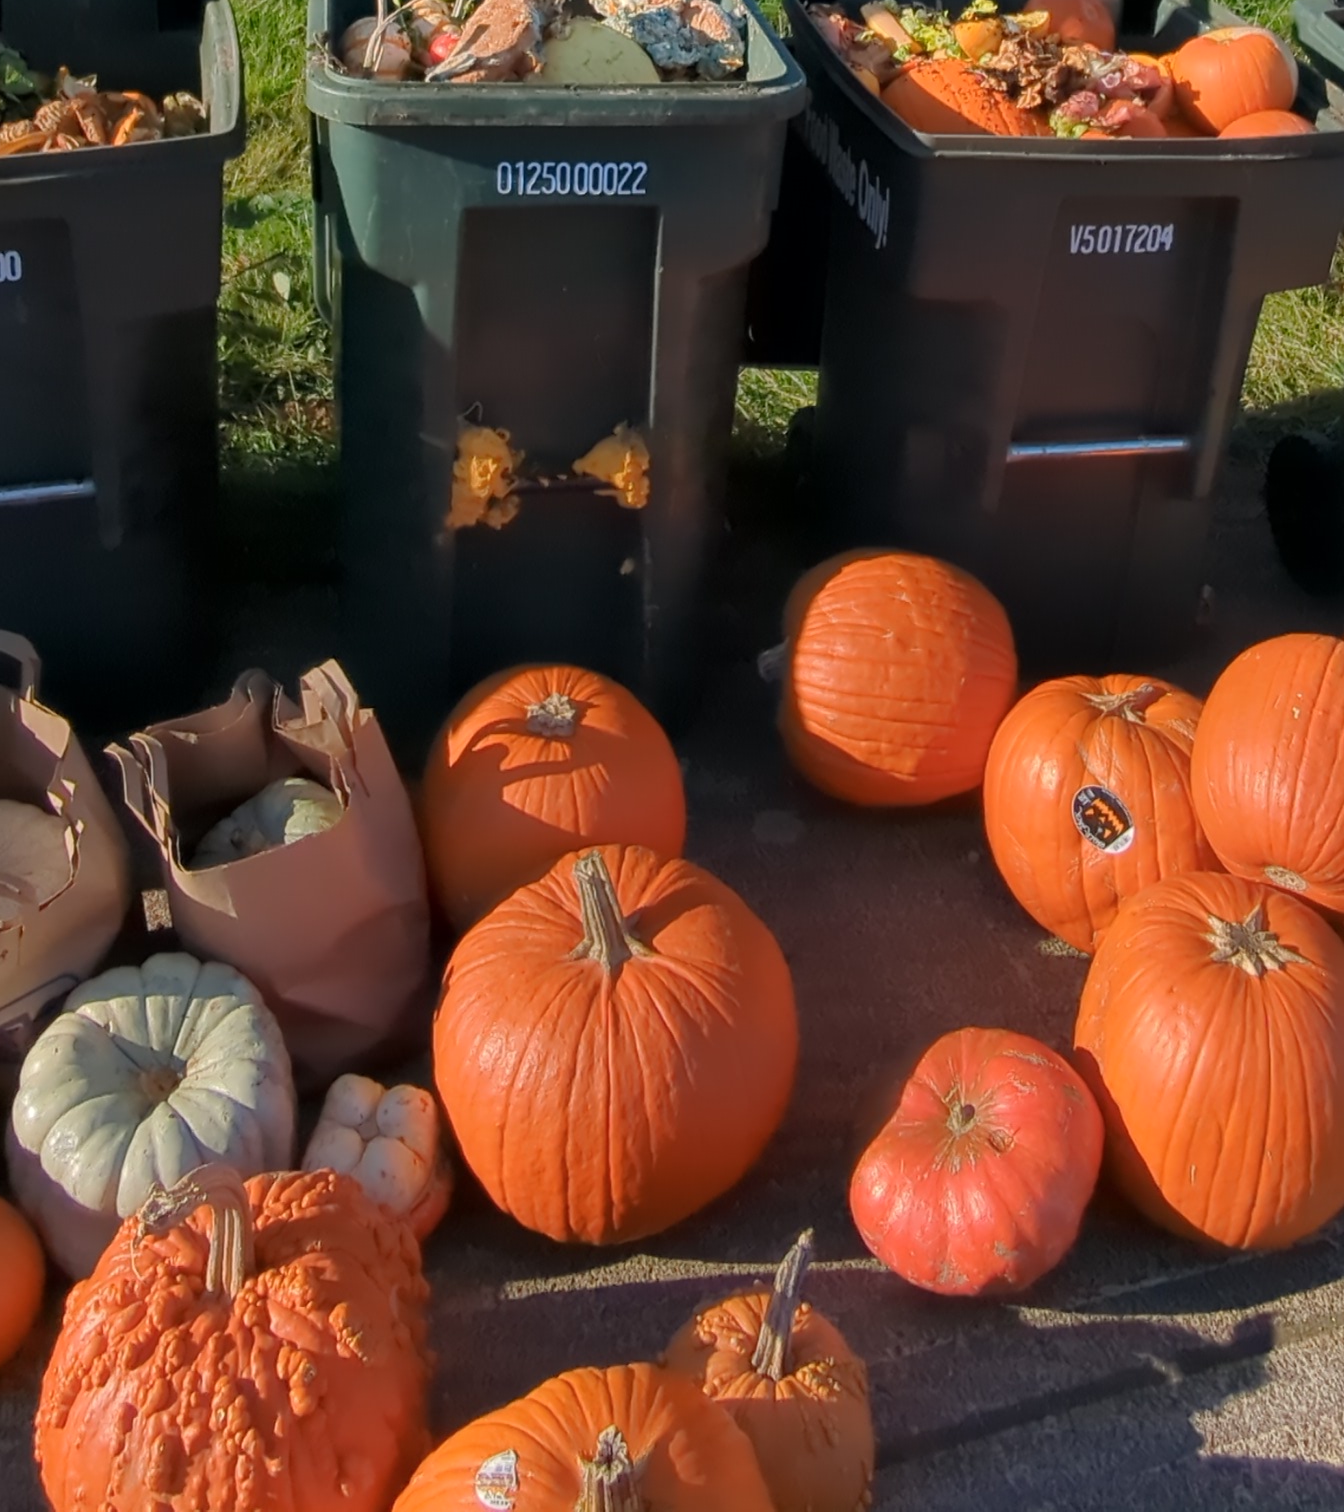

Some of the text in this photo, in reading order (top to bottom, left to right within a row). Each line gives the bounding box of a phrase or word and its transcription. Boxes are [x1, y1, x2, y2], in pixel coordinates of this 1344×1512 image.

[497, 161, 648, 195] 0125000022
[858, 159, 890, 250] Only!
[1070, 224, 1174, 254] V5017204
